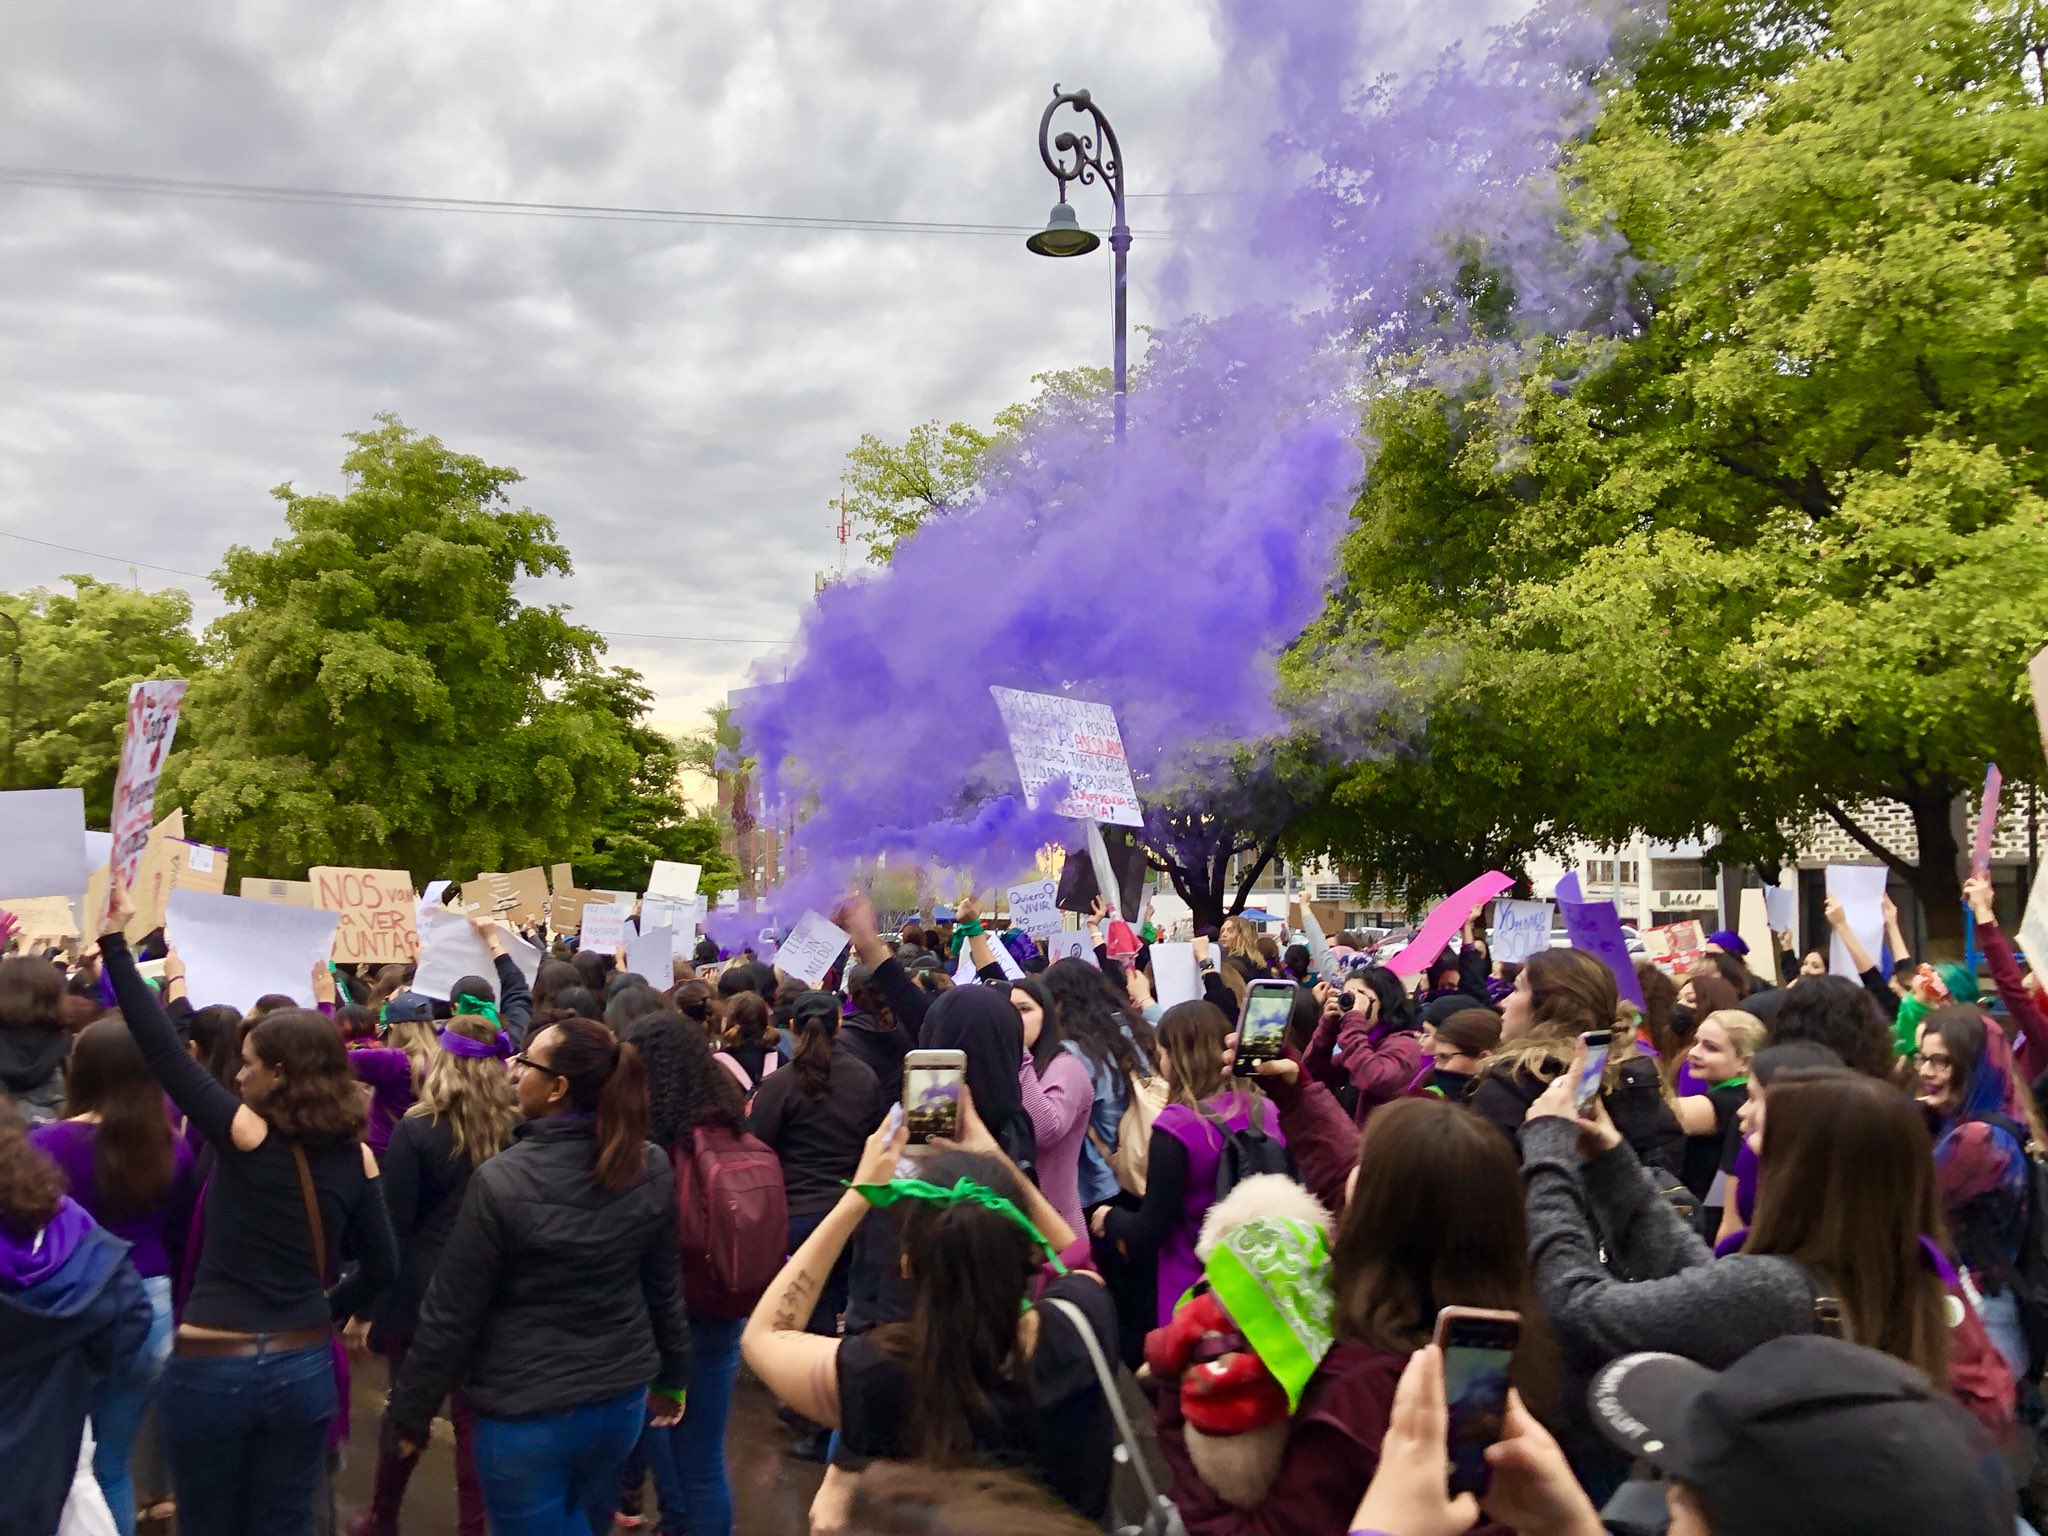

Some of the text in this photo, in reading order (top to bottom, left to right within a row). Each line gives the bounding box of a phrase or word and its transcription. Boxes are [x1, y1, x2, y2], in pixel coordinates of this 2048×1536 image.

[319, 873, 383, 909] NOS
[1010, 891, 1046, 905] Quiero
[1020, 901, 1051, 914] VIVIR
[360, 910, 407, 931] VER
[331, 930, 420, 959] UNTAS
[803, 940, 836, 977] MIEDO
